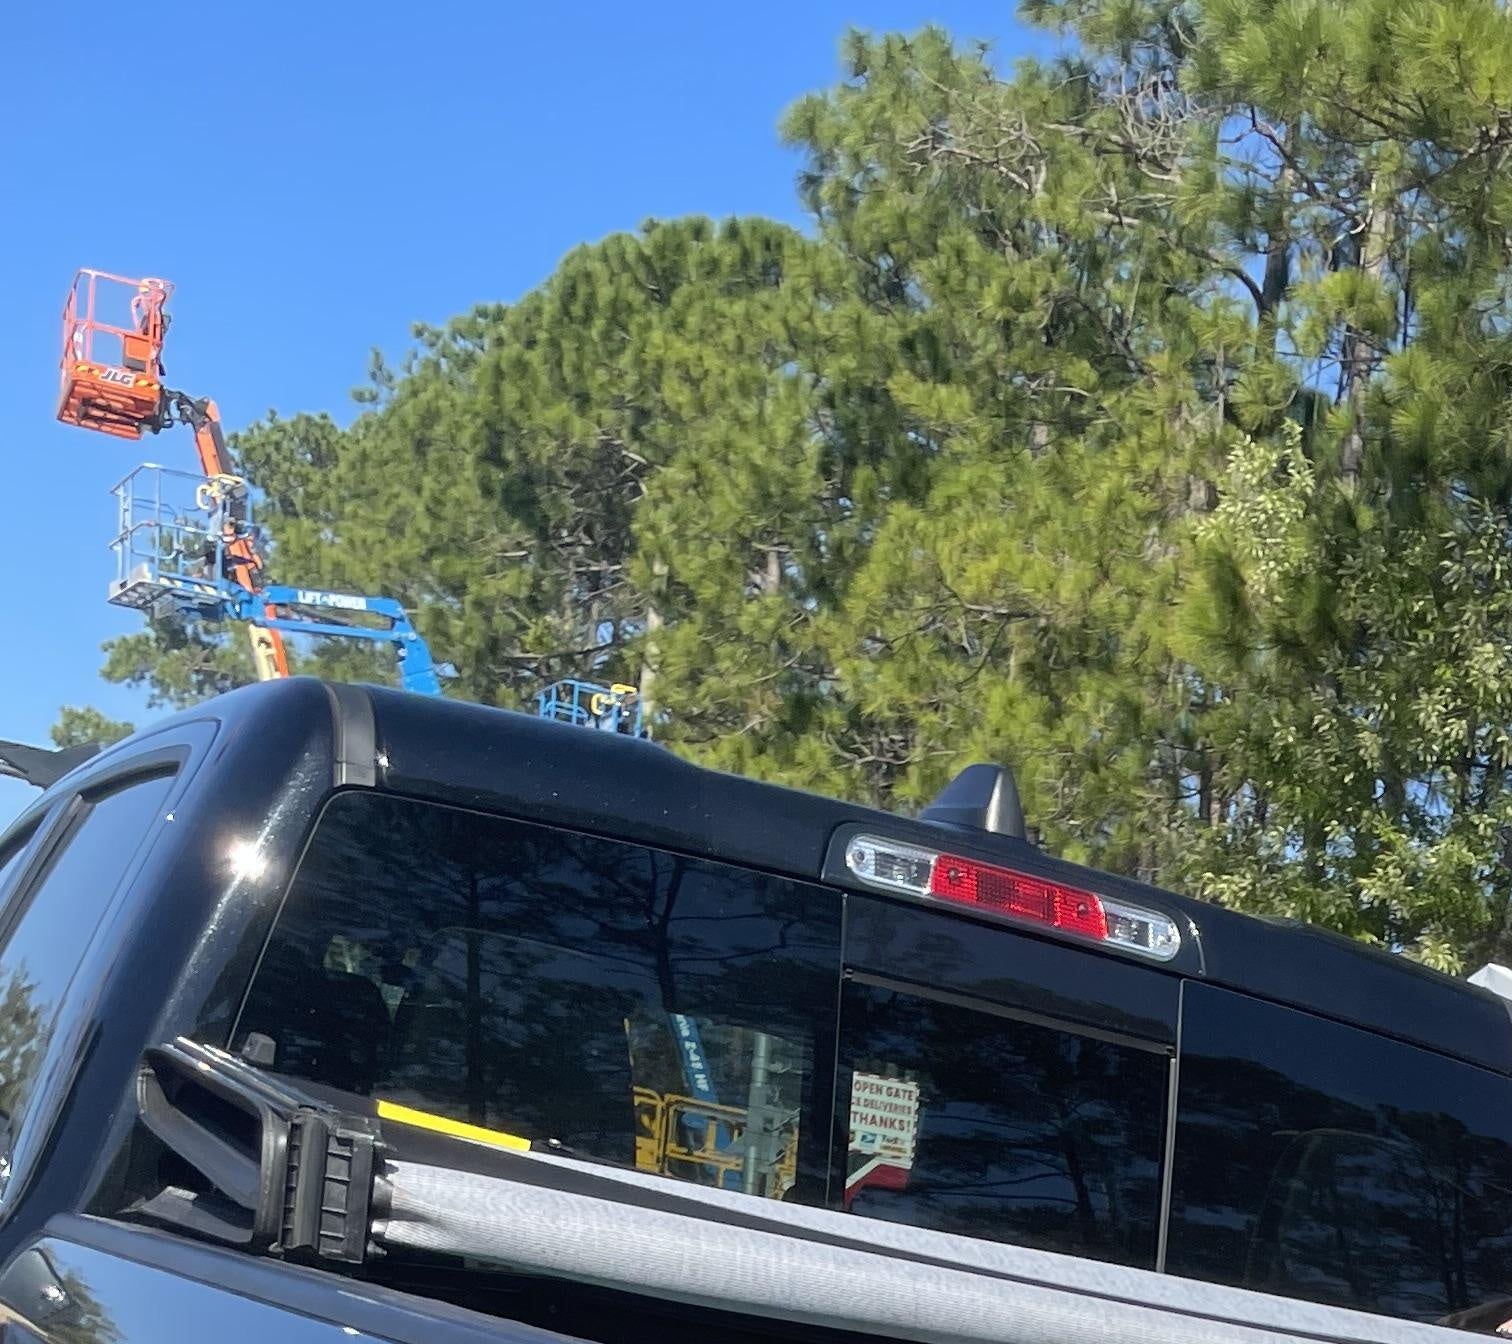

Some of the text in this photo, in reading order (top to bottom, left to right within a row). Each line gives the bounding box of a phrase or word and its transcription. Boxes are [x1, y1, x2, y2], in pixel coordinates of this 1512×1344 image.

[100, 369, 133, 386] JLG
[854, 1080, 914, 1102] OPEN GATE
[863, 1098, 912, 1115] DELIVERIES
[851, 1111, 910, 1133] THANKS!
